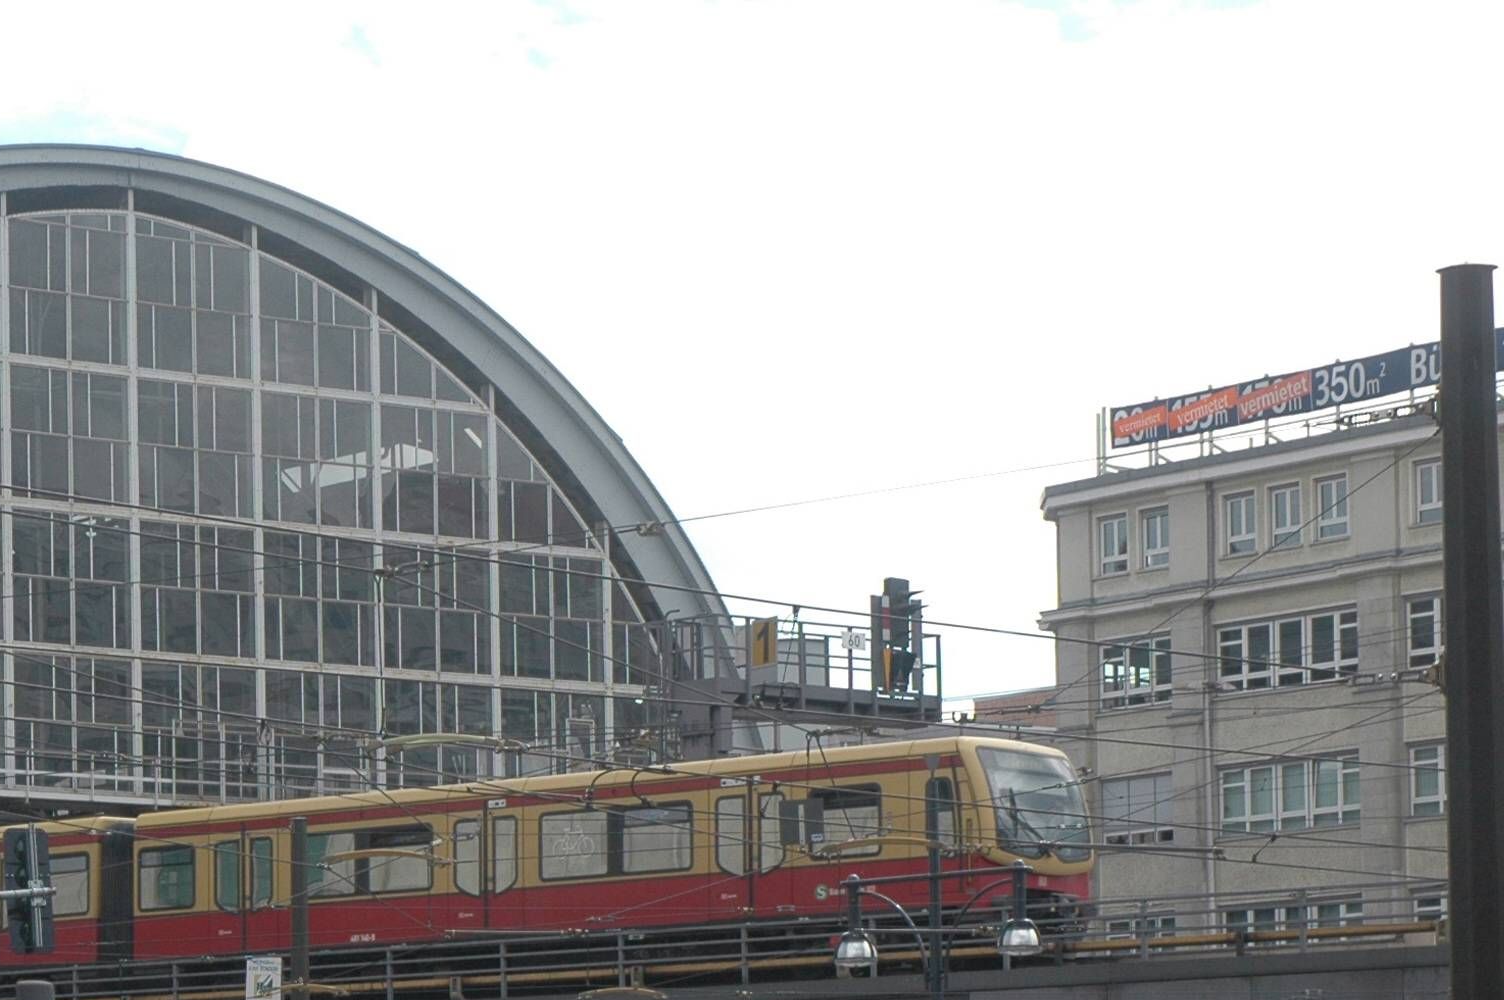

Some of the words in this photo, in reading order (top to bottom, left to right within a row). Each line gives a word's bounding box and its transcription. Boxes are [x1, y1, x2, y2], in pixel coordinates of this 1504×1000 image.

[1177, 395, 1229, 425] vermietet
[1240, 377, 1308, 416] vermietet
[757, 621, 770, 664] 1
[848, 634, 861, 648] 60
